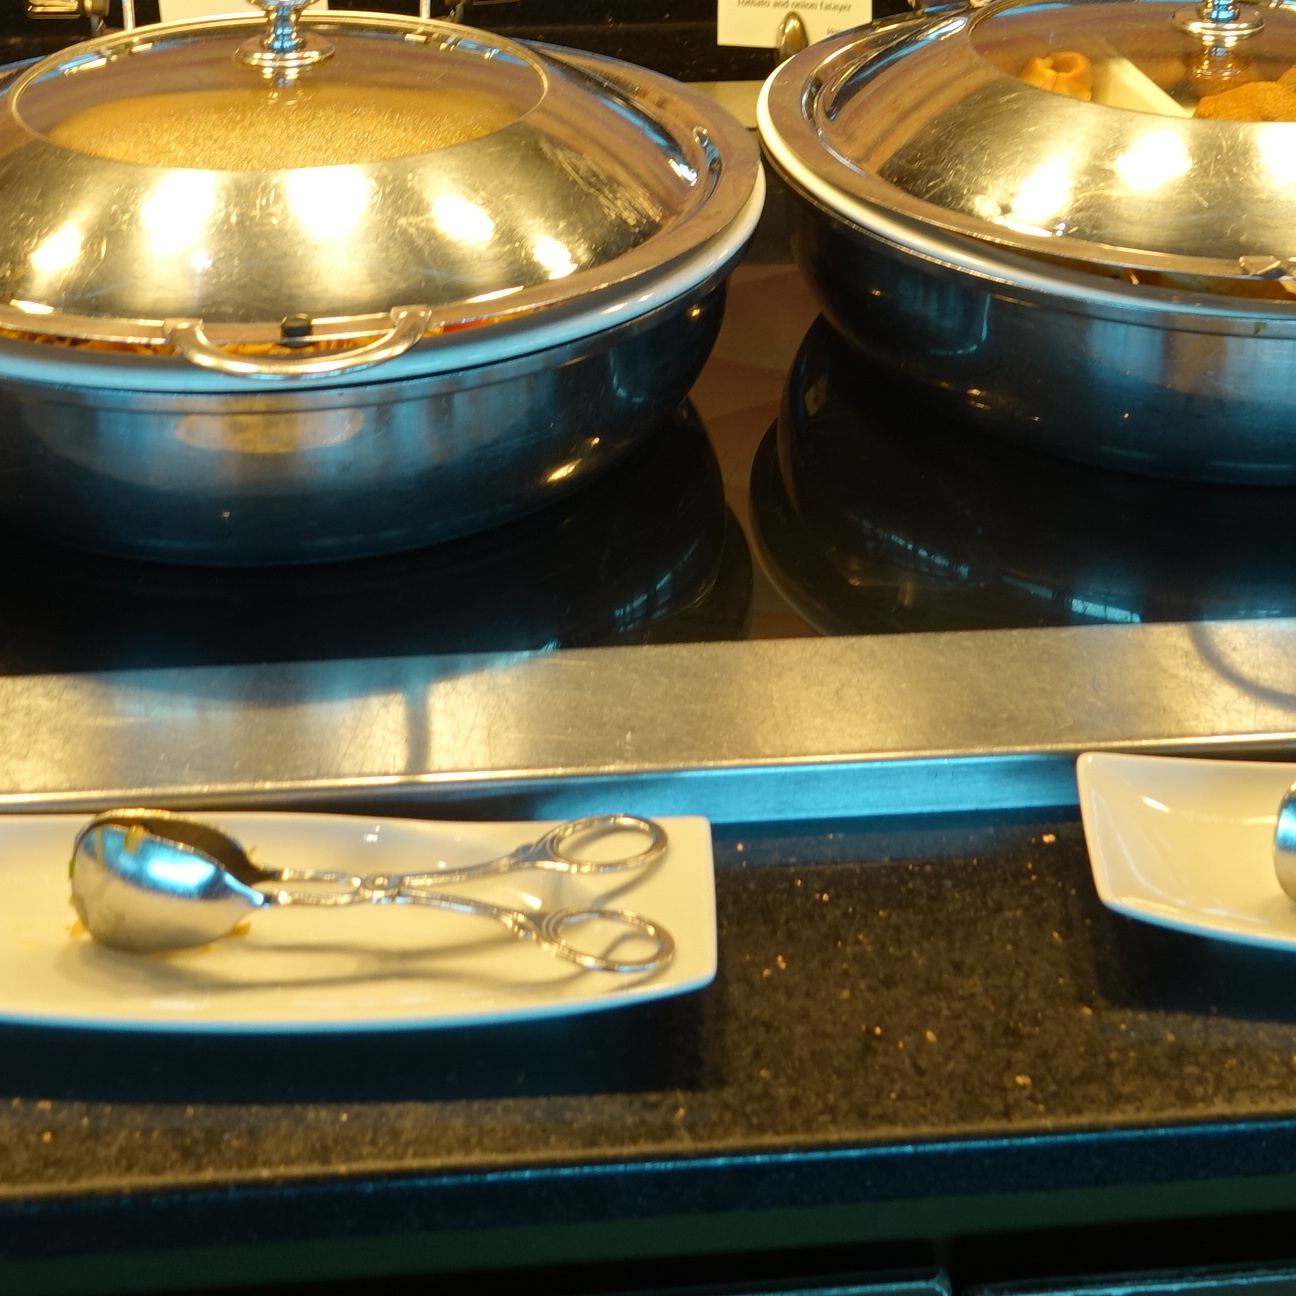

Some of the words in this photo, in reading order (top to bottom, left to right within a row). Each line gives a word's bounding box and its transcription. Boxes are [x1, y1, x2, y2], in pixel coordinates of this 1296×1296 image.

[772, 0, 790, 9] and
[791, 0, 818, 11] onion
[819, 0, 852, 13] fatayer
